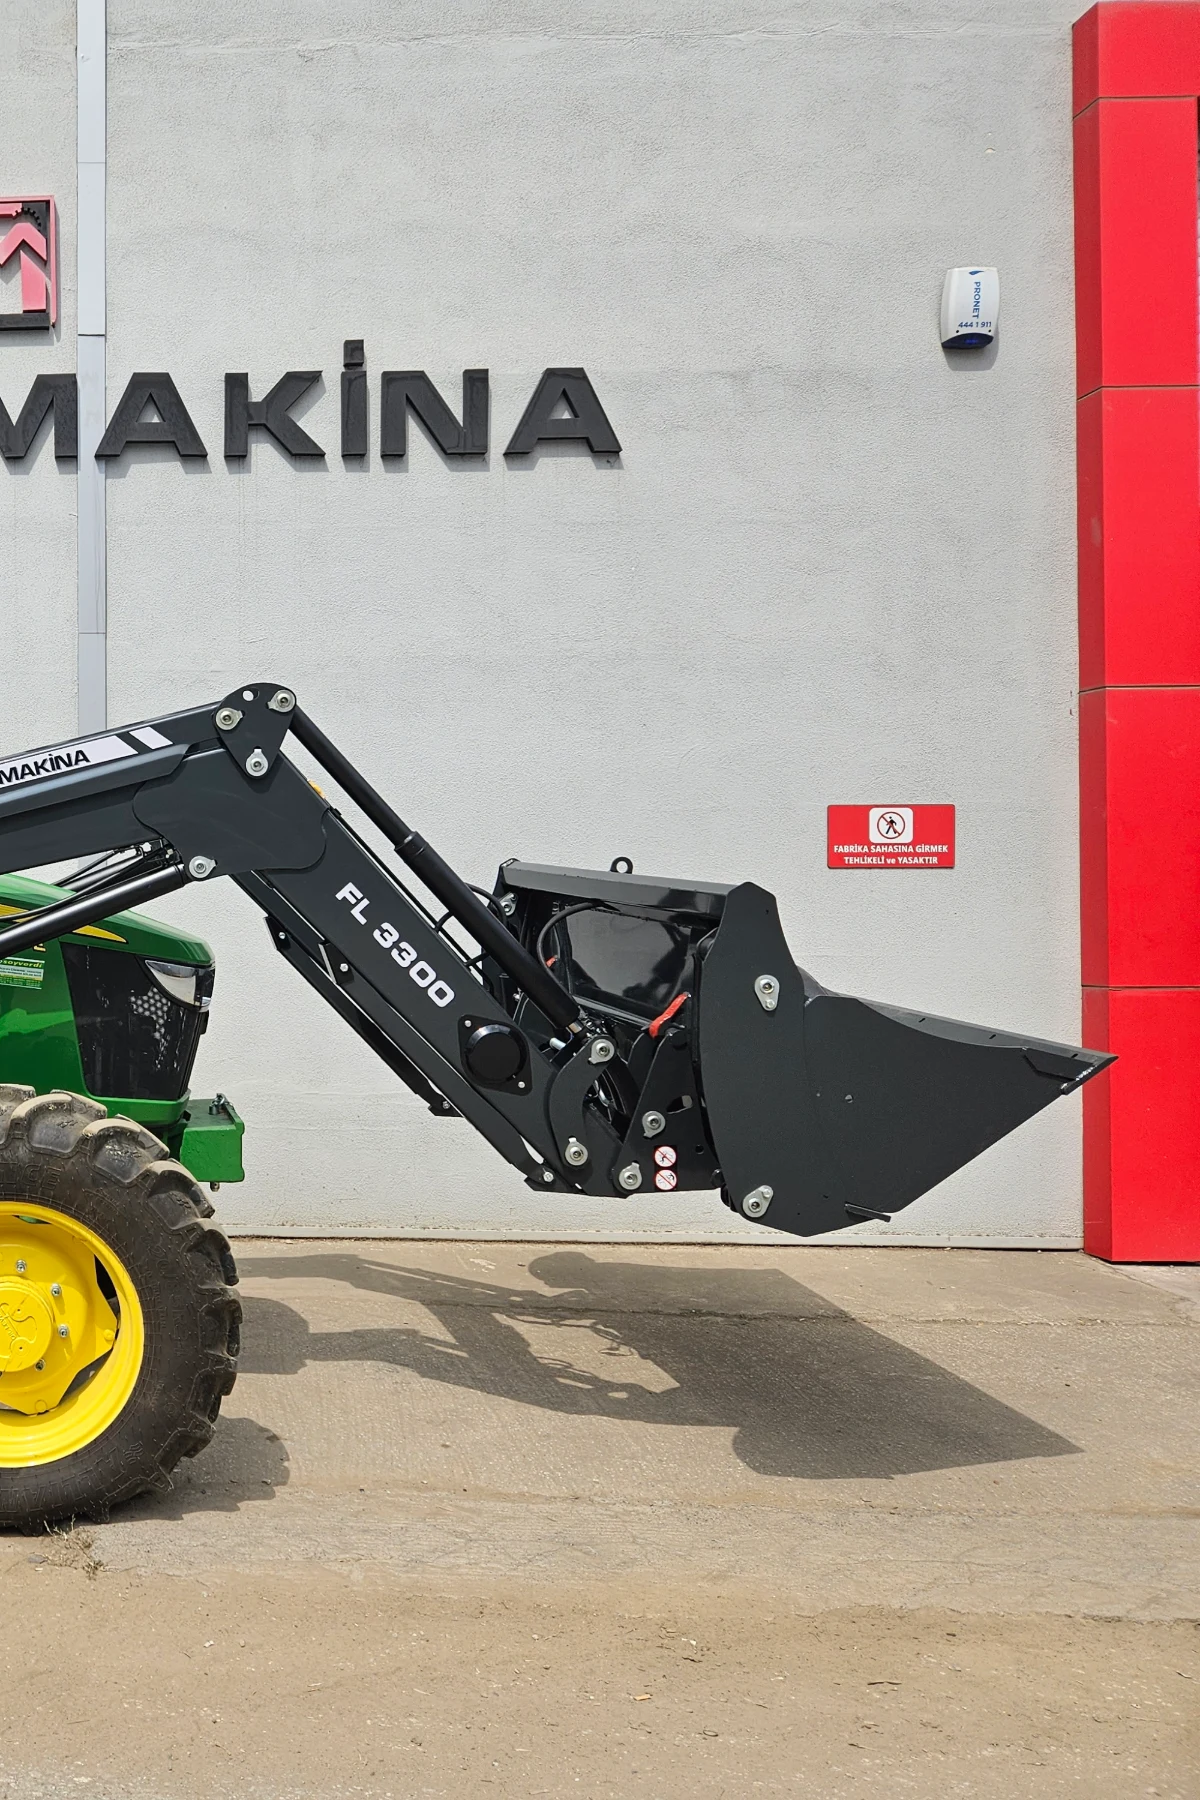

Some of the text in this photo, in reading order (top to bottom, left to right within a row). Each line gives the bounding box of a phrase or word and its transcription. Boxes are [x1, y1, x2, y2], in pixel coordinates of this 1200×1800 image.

[972, 281, 981, 319] PRONET
[834, 843, 949, 853] FABRİKA SAHASINA GİRMEK
[844, 855, 885, 864] TEHLİKELİ
[898, 856, 938, 864] YASAKTIR
[335, 882, 455, 1007] FL 3300
